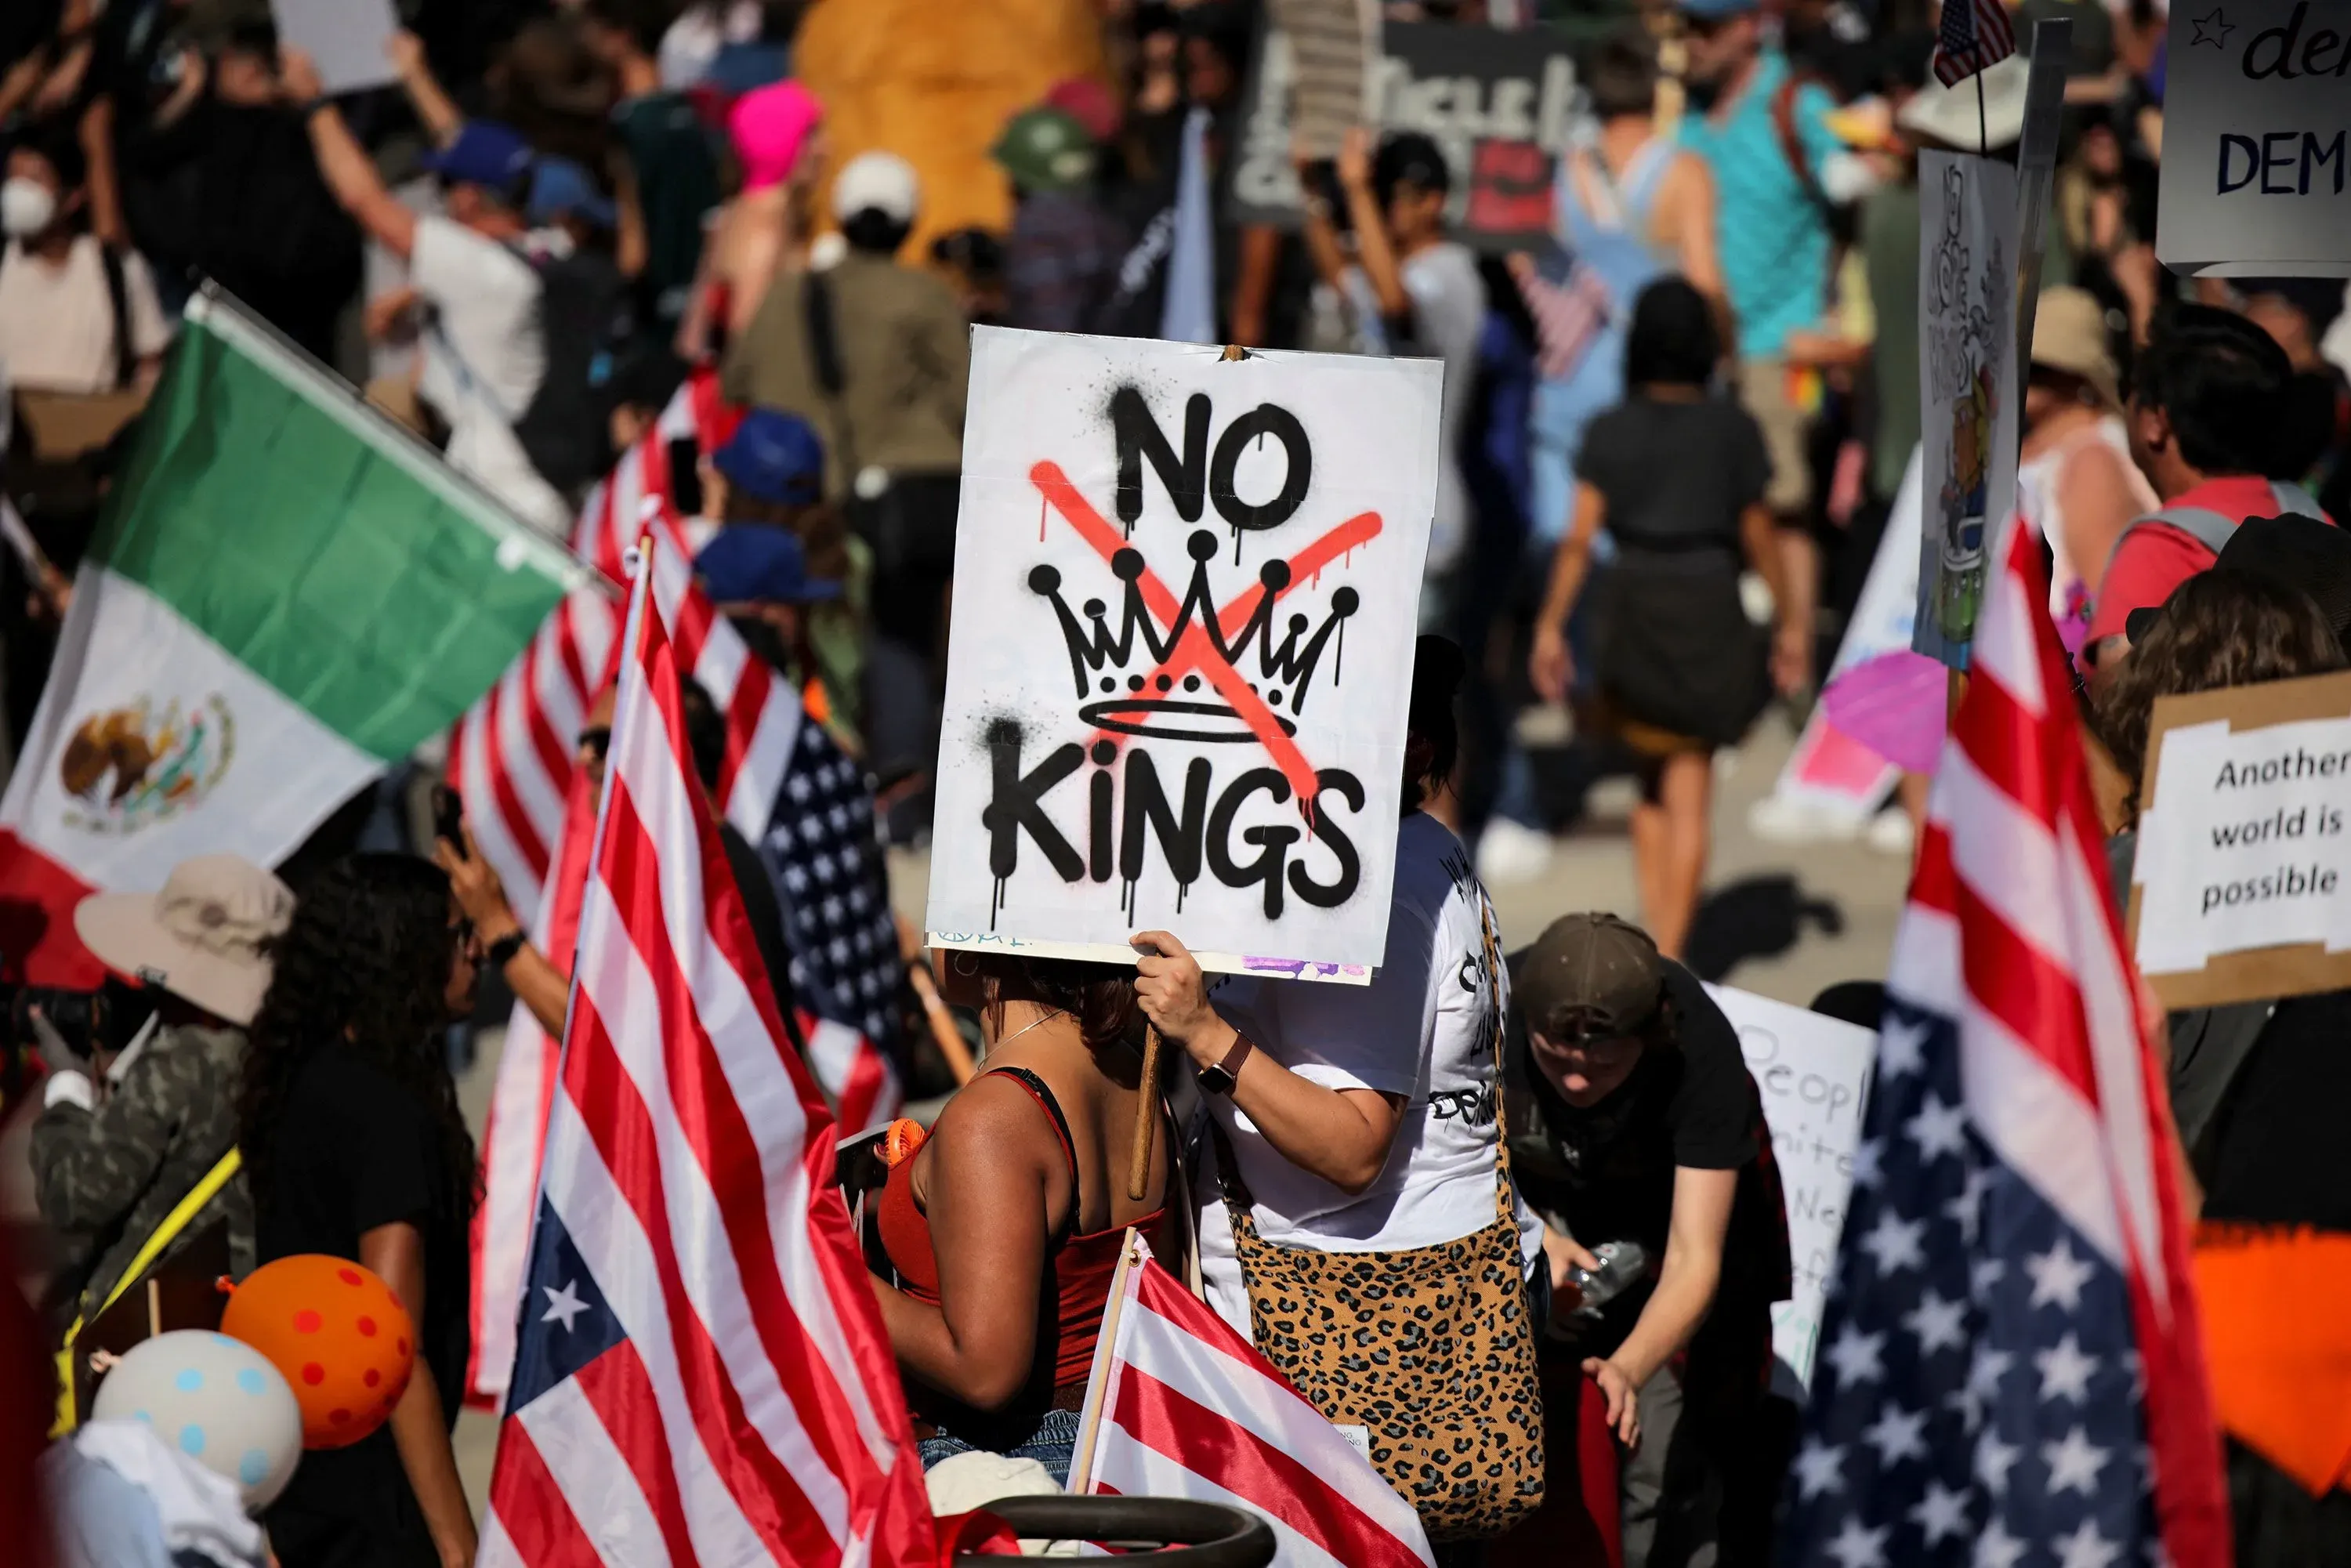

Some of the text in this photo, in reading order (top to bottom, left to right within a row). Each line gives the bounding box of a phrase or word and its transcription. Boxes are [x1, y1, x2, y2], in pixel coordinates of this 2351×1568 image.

[2217, 130, 2351, 196] DEM
[1110, 386, 1313, 533] NO
[2215, 746, 2351, 791] Another
[2212, 804, 2343, 849] world is
[2201, 864, 2338, 917] possible
